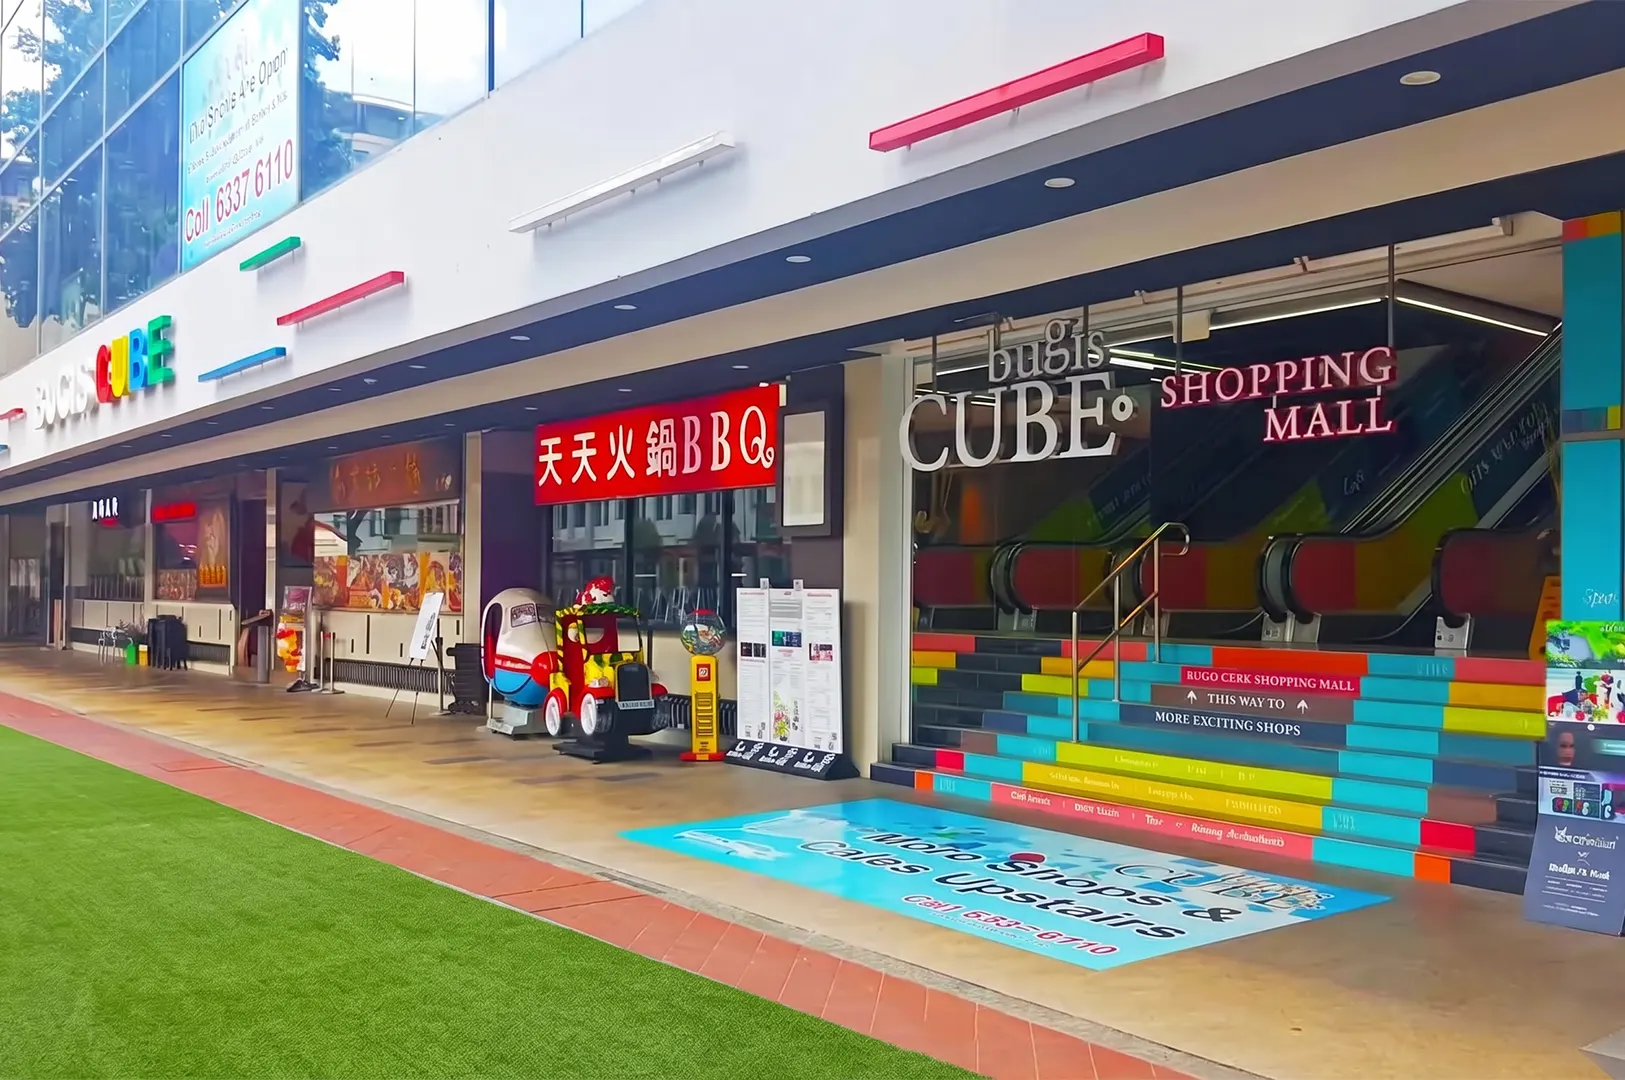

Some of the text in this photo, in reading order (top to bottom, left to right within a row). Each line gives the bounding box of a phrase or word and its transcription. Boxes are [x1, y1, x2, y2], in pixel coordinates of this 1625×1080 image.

[216, 168, 250, 223] 6337
[254, 138, 293, 198] 6110
[96, 315, 176, 404] CUBE
[988, 318, 1105, 383] bugis
[1161, 346, 1392, 408] SHOPPING
[1263, 397, 1392, 442] MALL
[1186, 670, 1355, 692] RUGO CERK SHOPPING MALL
[1207, 693, 1285, 710] THIS WAY TO
[1155, 711, 1301, 736] MORE EXCITING SHOPS
[935, 873, 1186, 938] Upstairs
[1183, 907, 1242, 922] &
